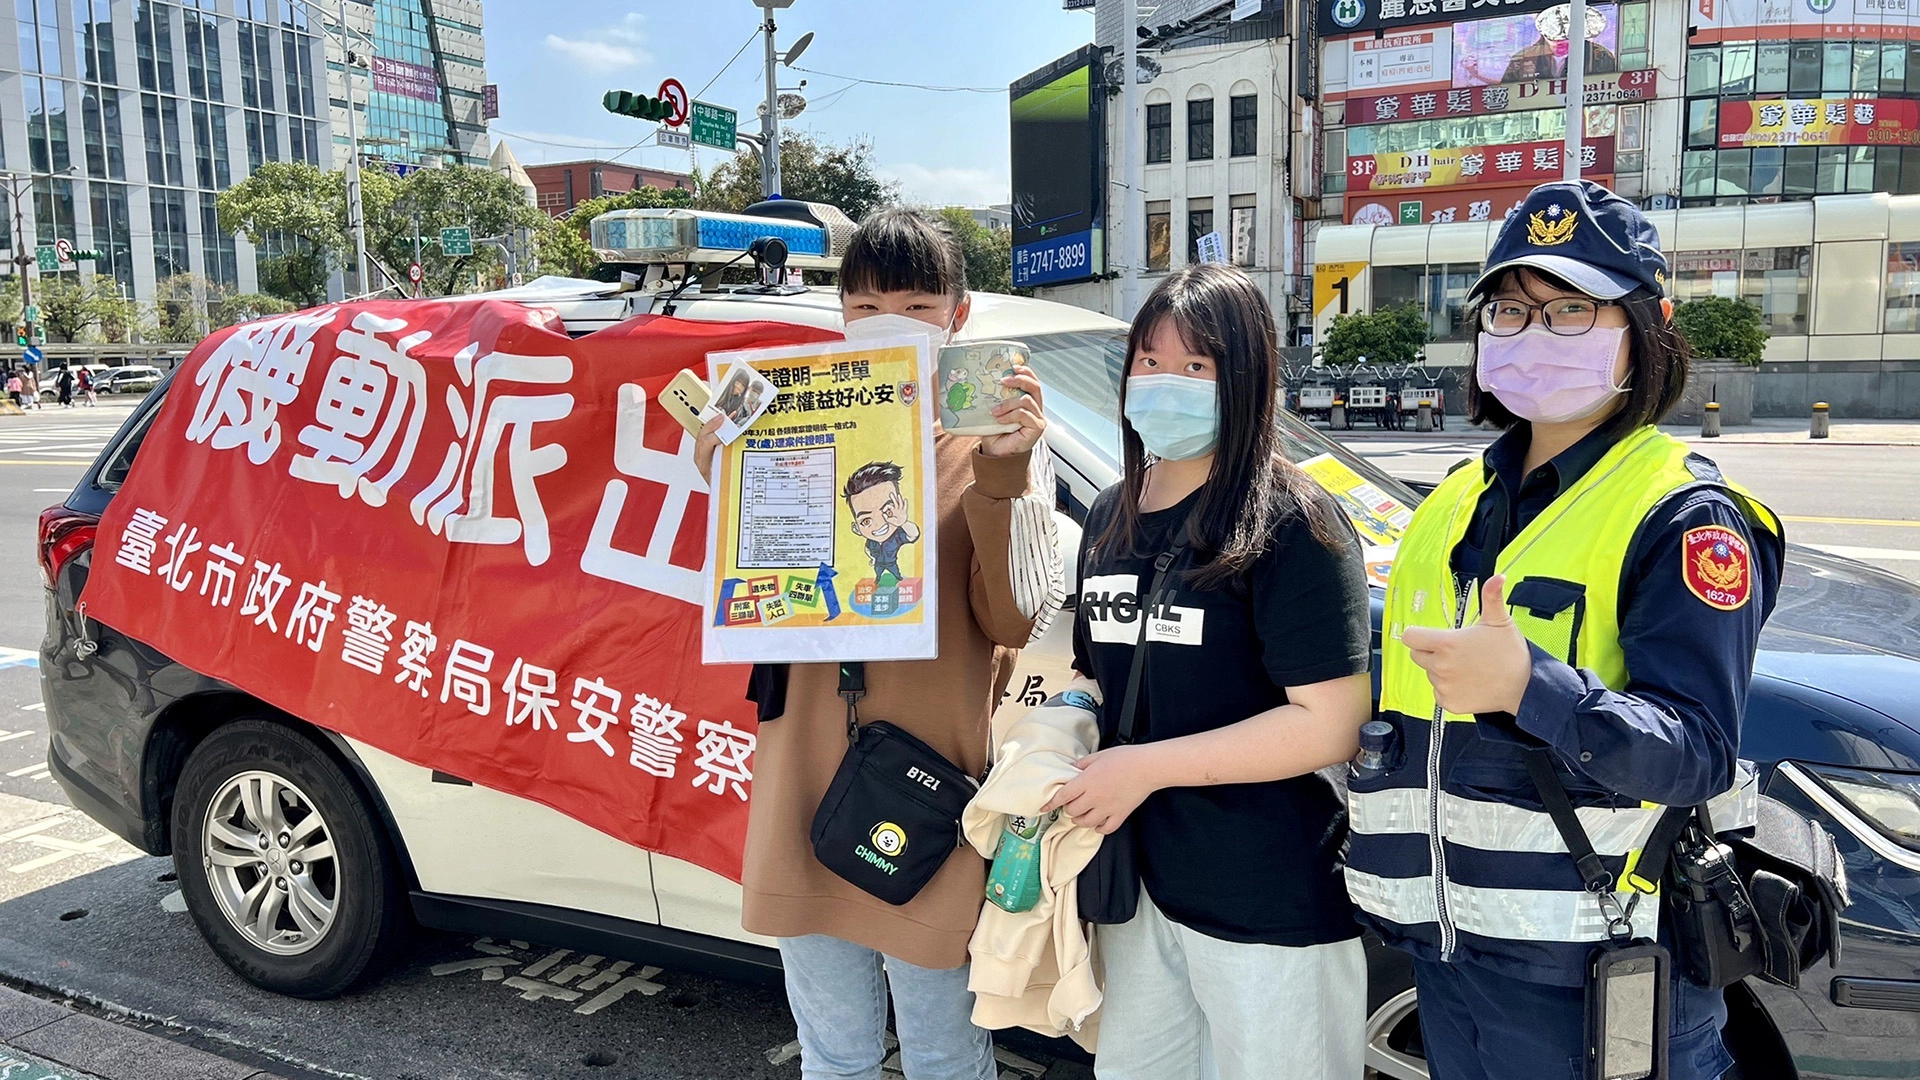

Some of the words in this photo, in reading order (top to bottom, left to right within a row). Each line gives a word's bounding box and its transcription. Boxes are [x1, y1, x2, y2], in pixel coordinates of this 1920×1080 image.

[1631, 70, 1655, 84] 3F
[1565, 89, 1643, 103] ()2371-0641
[1352, 160, 1376, 176] 3F
[1433, 157, 1456, 166] hair
[1030, 242, 1085, 274] 2747-8899
[1332, 277, 1348, 314] 1
[733, 601, 751, 611] 刑案
[1705, 588, 1737, 605] 16278
[769, 608, 786, 620] 人口
[1154, 623, 1181, 635] CBKS
[115, 506, 757, 803] 臺北市政府警察局保安警察
[1015, 674, 1048, 707] 局
[905, 765, 941, 791] BT21
[854, 844, 899, 876] CHIMMY
